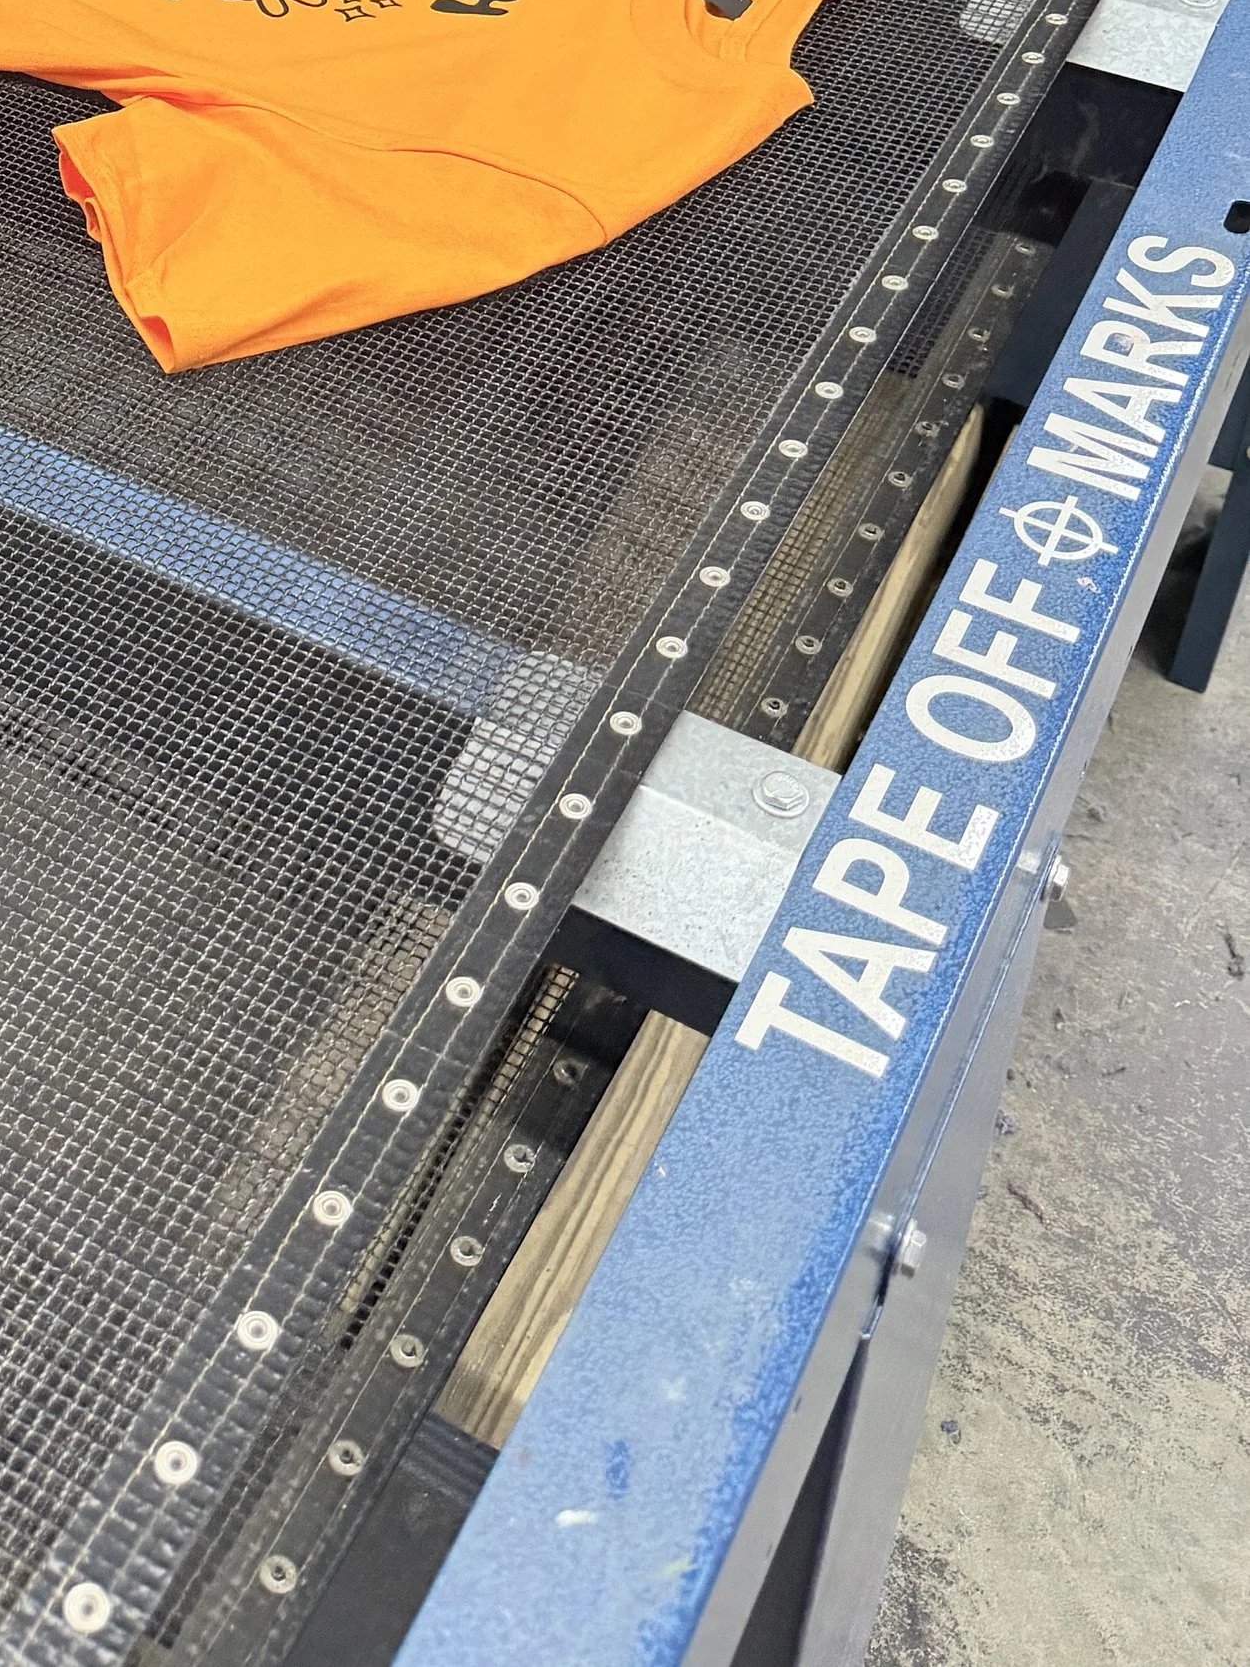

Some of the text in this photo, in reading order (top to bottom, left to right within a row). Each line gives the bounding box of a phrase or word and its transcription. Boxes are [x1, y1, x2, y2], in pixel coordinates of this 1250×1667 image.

[734, 232, 1238, 1080] TAPE OFF MARKS
